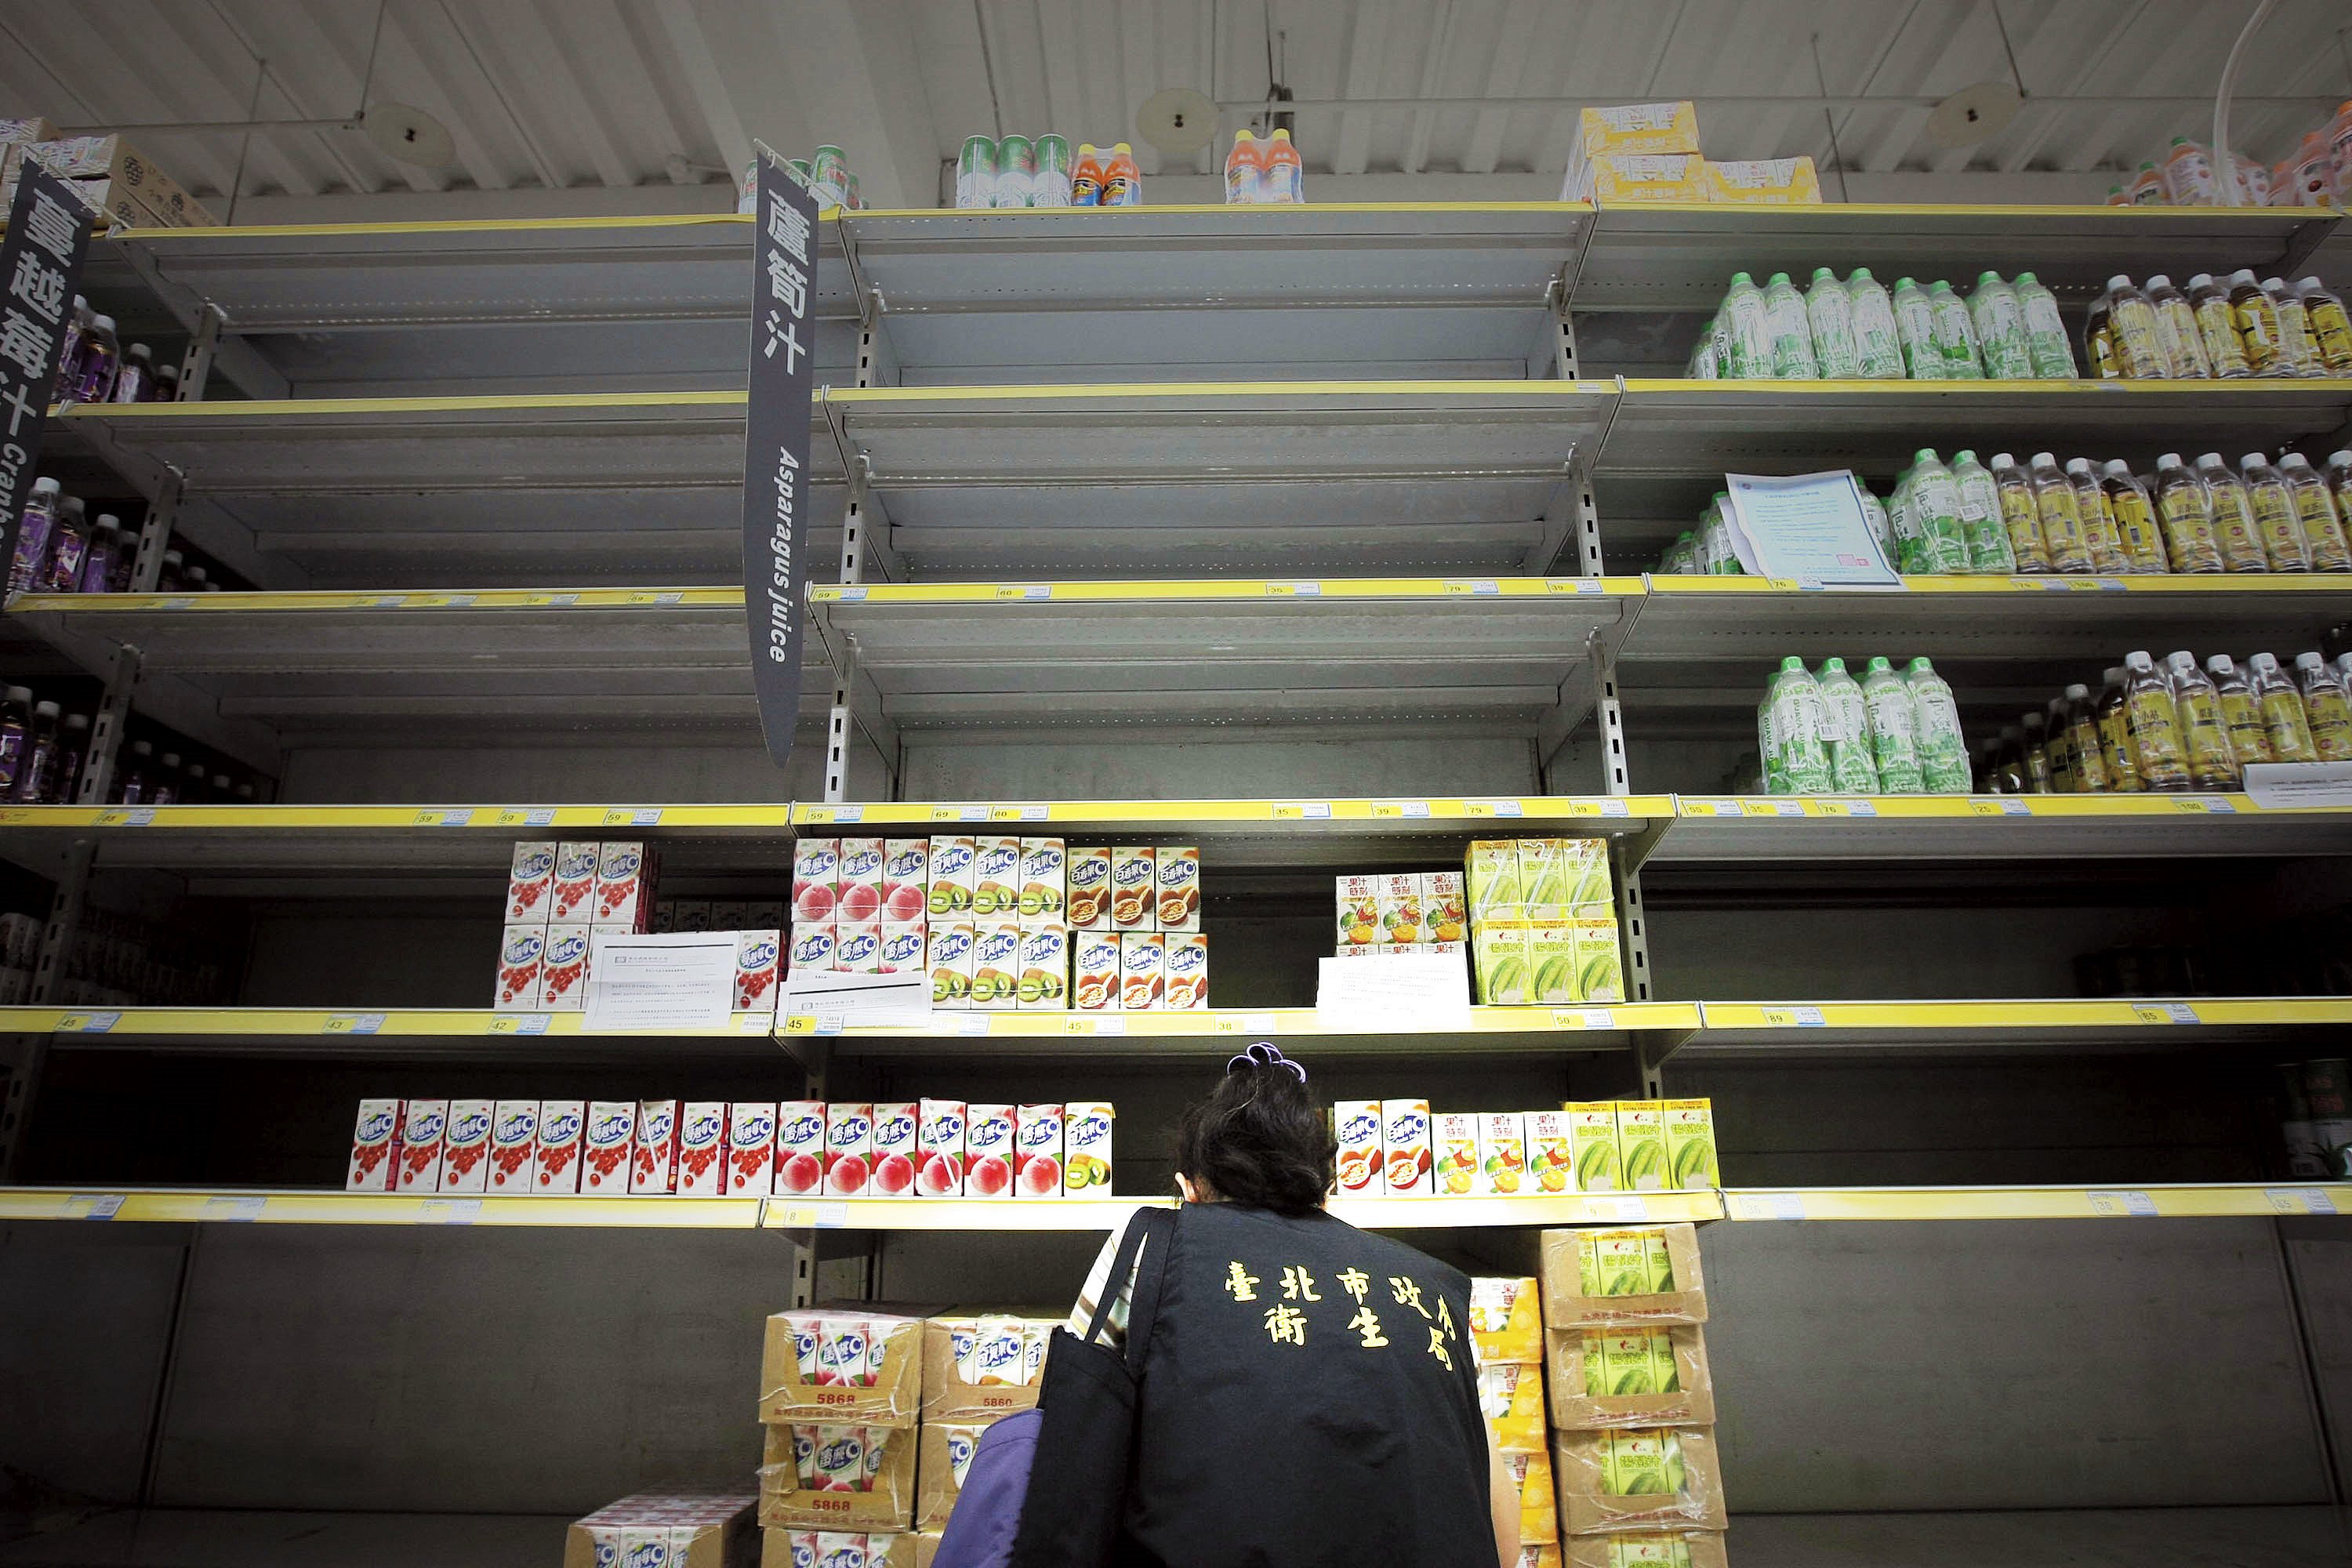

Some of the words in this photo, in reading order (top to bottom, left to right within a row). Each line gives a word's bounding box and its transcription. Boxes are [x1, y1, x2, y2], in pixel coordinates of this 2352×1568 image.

[764, 187, 810, 376] 蘆筍汁
[770, 446, 800, 590] Asparagus
[767, 588, 793, 663] juice
[1348, 877, 1367, 887] 果汁
[1391, 876, 1409, 886] 果汁
[1348, 946, 1367, 956] 果汁
[1436, 944, 1454, 953] 果汁
[1769, 1014, 1784, 1023] 89
[789, 1020, 802, 1029] 45
[1445, 1116, 1465, 1126] 果汁
[1494, 1116, 1512, 1126] 果汁
[1537, 1114, 1556, 1124] 果汁
[1264, 1302, 1454, 1372] 衛生局
[817, 1393, 855, 1404] 5868
[812, 1500, 851, 1512] 5868
